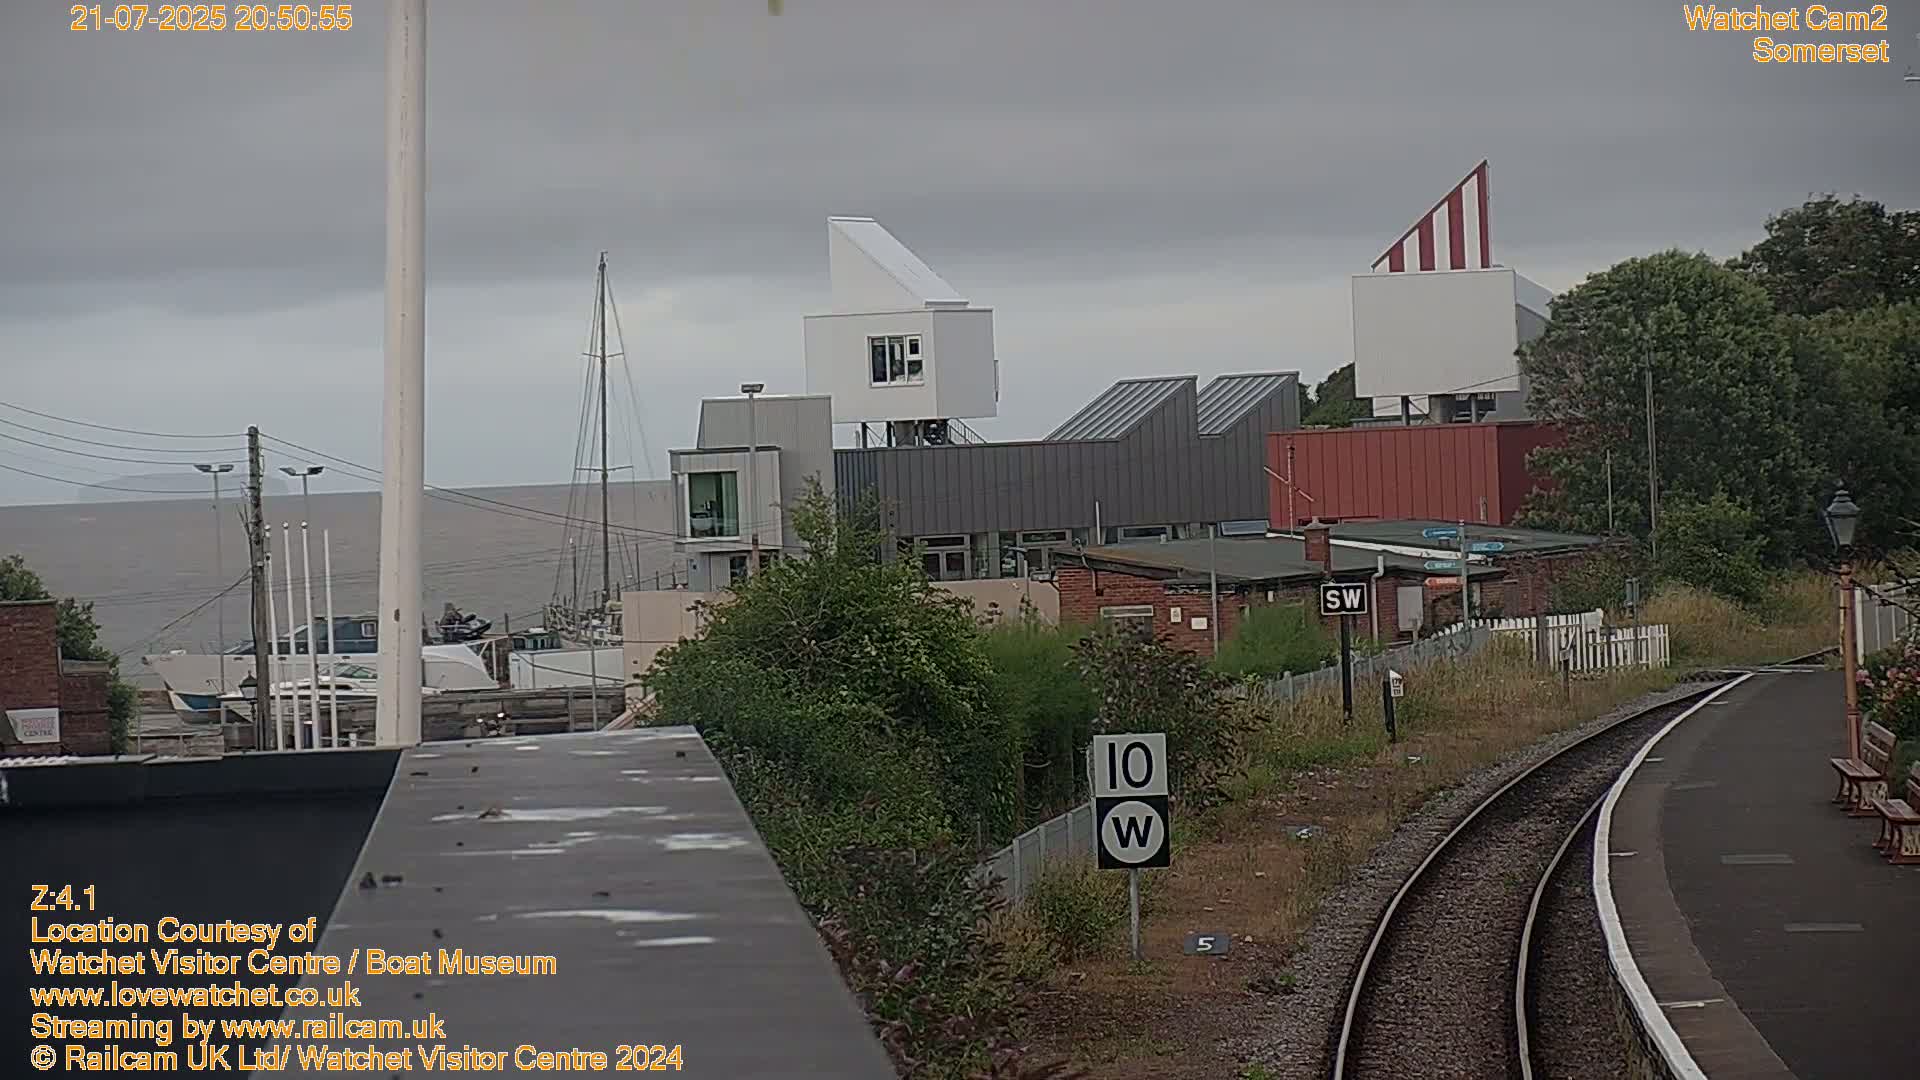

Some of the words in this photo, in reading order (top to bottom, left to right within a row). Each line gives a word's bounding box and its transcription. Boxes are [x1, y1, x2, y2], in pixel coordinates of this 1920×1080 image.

[1325, 588, 1362, 610] SW
[1107, 741, 1154, 790] 10
[1111, 815, 1154, 849] W
[1196, 936, 1216, 952] 5
